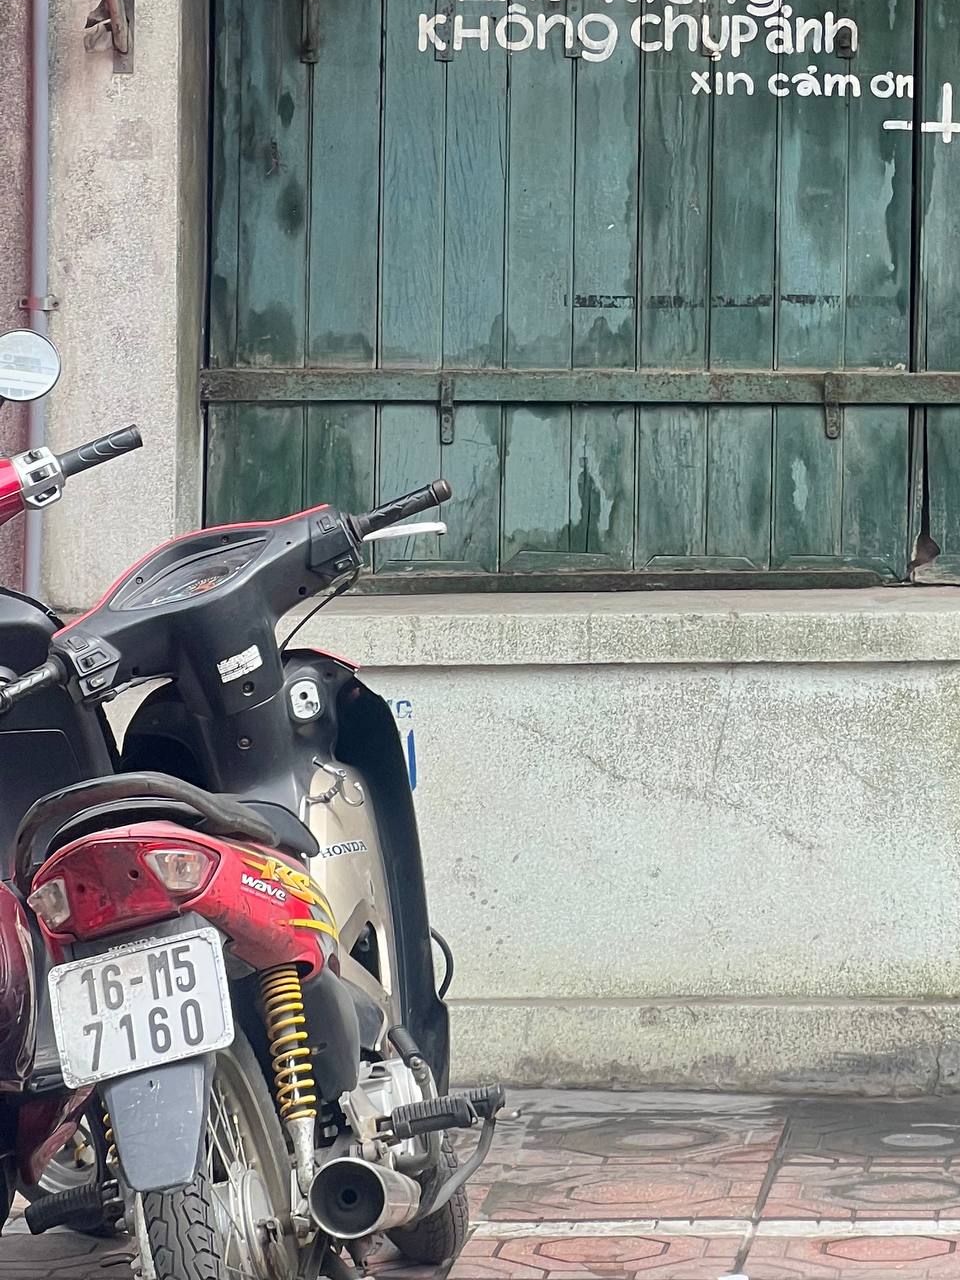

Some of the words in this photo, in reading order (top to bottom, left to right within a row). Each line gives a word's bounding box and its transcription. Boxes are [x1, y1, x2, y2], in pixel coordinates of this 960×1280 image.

[630, 5, 759, 62] chụp
[764, 4, 858, 56] ảnh
[767, 65, 861, 98] cảm
[869, 70, 914, 99] ơn
[320, 840, 368, 859] HONDA
[241, 872, 287, 902] wave
[80, 944, 197, 1016] 16-M5
[82, 998, 205, 1072] 7160
